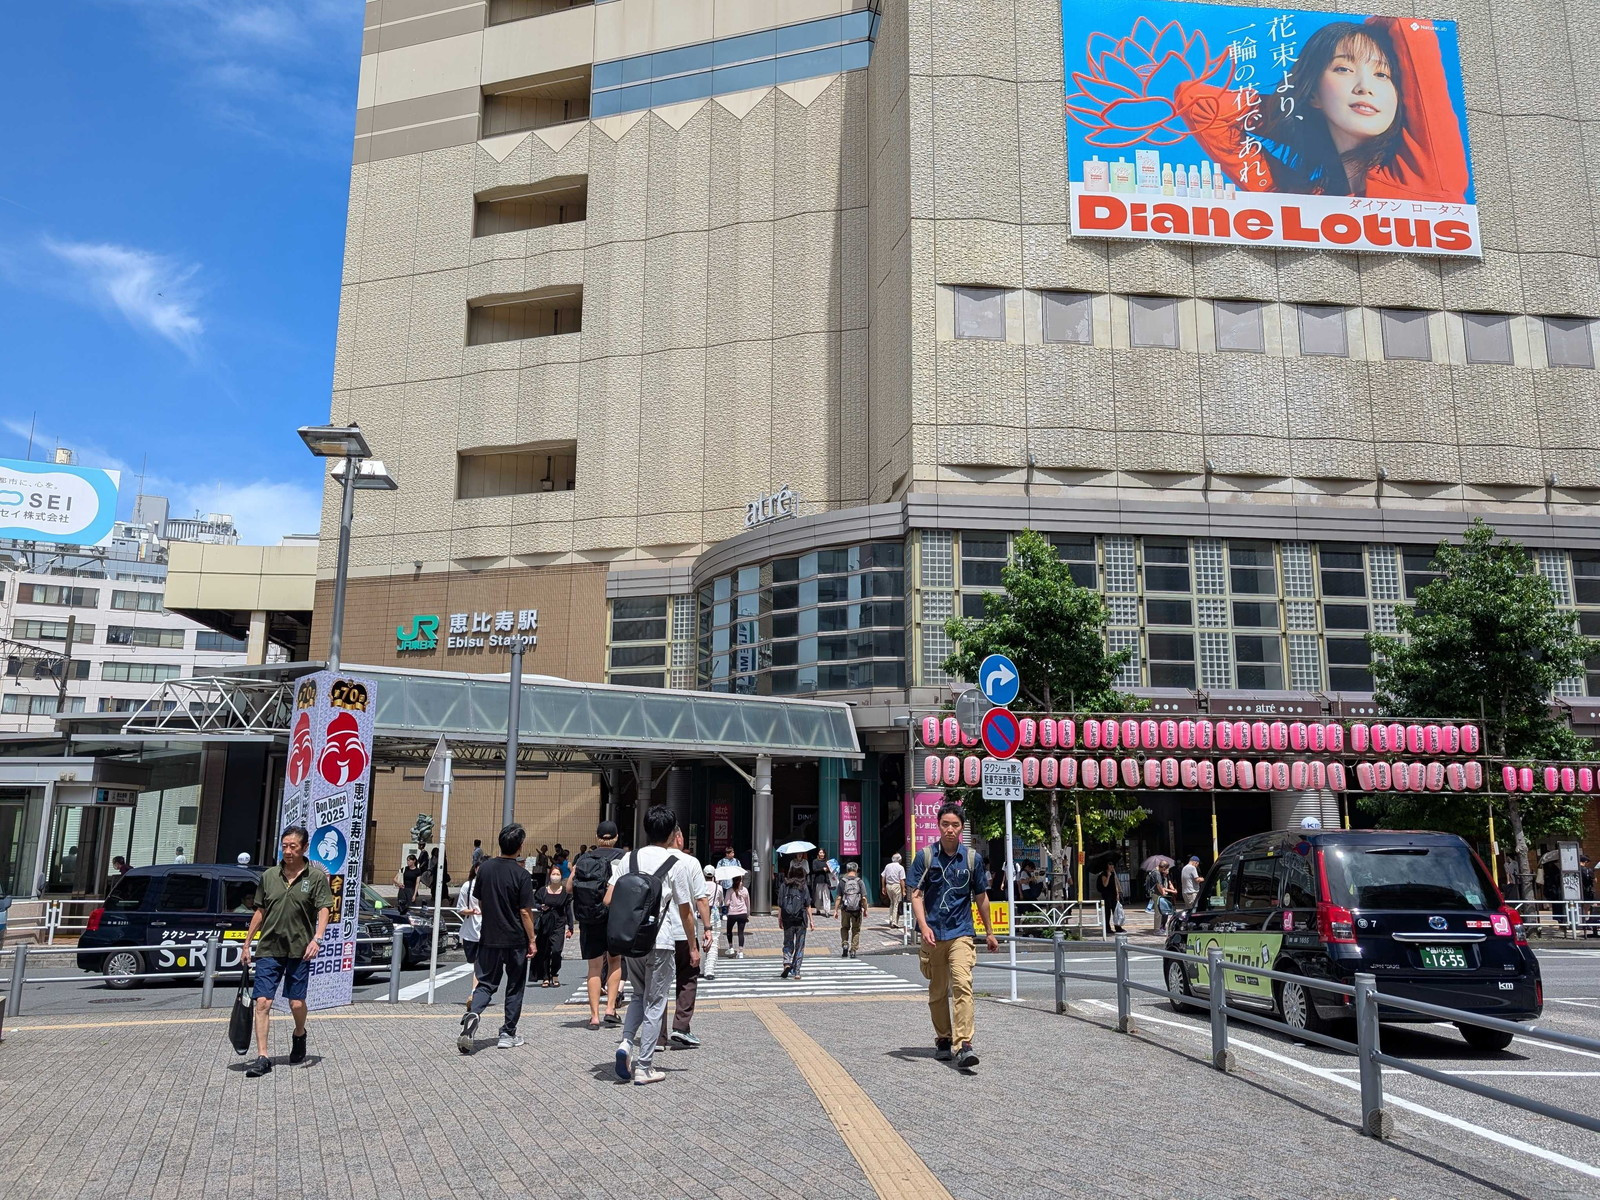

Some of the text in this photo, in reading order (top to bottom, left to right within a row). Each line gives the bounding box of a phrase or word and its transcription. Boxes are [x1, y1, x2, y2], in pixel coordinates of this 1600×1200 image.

[1266, 14, 1304, 121] 花束より、
[1227, 23, 1268, 188] 一輪の花であれ。
[1349, 199, 1465, 217] ダイアン ロータス
[1078, 195, 1473, 252] Diane Lotus
[745, 484, 793, 528] atré
[396, 614, 440, 642] JR
[449, 609, 538, 634] 恵比寿駅
[396, 639, 438, 651] JR東日本
[447, 635, 484, 649] Ebisu
[1255, 702, 1276, 713] atré
[984, 763, 1021, 774] タクシーを除く
[987, 787, 1020, 796] ここまで
[316, 795, 347, 814] Bon Dance
[321, 807, 345, 825] 2025
[343, 782, 365, 939] 恵比寿駅前盆踊り
[1370, 920, 1377, 928] 7
[161, 929, 221, 940] タクシーアプリ
[344, 942, 353, 955] 金
[343, 958, 353, 972] 土
[1432, 954, 1465, 967] 16-55
